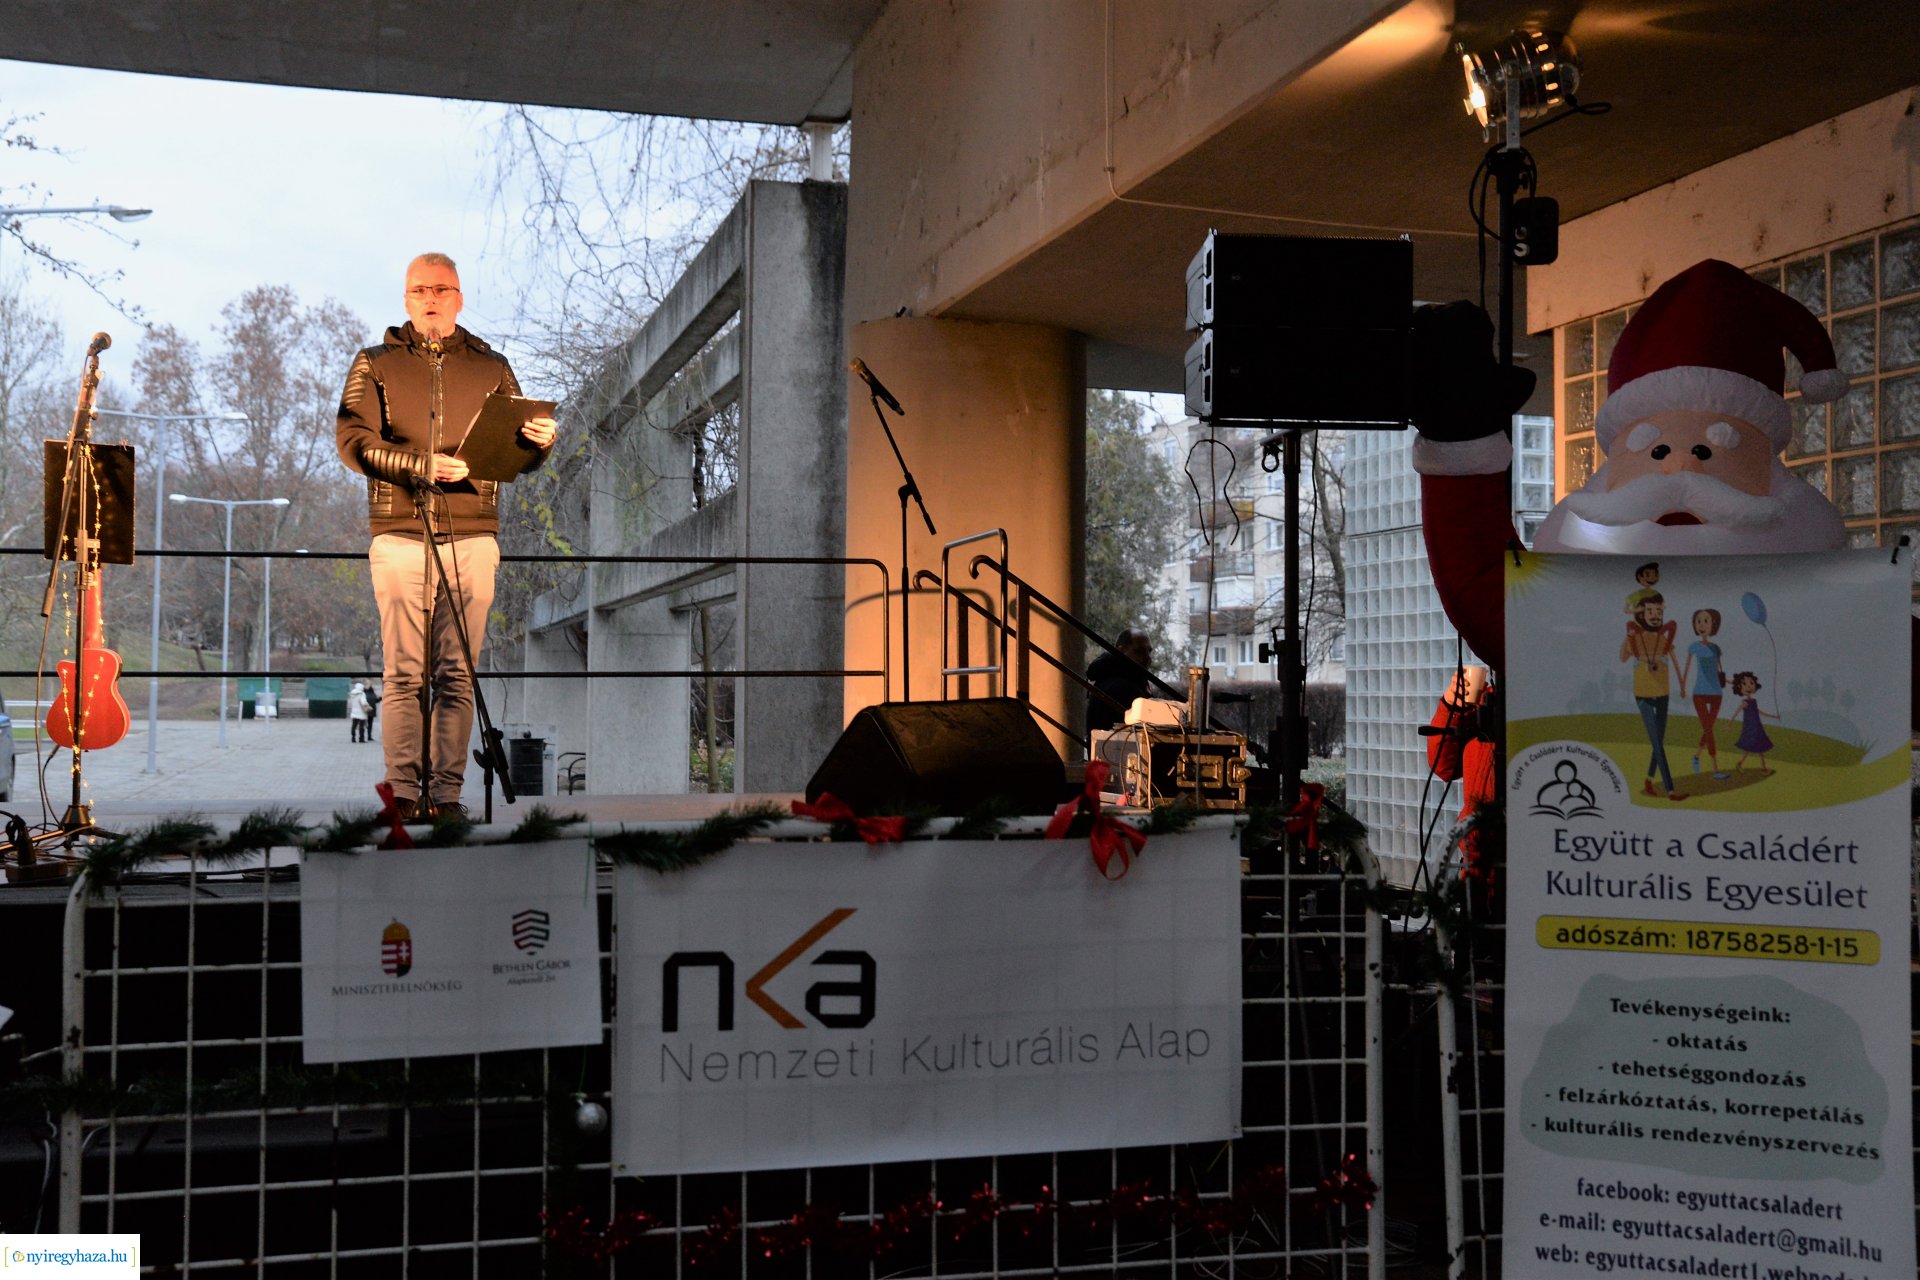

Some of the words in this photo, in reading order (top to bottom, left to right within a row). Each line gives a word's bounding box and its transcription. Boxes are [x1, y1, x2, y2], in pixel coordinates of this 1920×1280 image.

[1555, 828, 1653, 861] Együtt
[1666, 839, 1684, 858] a
[1697, 833, 1859, 864] Családért
[1546, 870, 1692, 901] Kulturális
[1706, 876, 1868, 911] Egyesület
[1556, 924, 1677, 948] adószám:
[1686, 929, 1859, 957] 18758258-1-15
[1610, 998, 1791, 1025] Tevékenységeink:
[660, 1039, 875, 1083] Nemzeti
[902, 1025, 1100, 1074] Kulturális
[1116, 1022, 1211, 1064] Alap
[1667, 1033, 1748, 1052] oktatás
[1611, 1060, 1807, 1088] tehetséggondozás
[1558, 1086, 1718, 1115] felzárkóztatás,
[1725, 1098, 1865, 1125] korrepetálás
[1544, 1117, 1644, 1139] kulturális
[1651, 1127, 1880, 1161] rendezvényszervezés
[1577, 1177, 1670, 1204] facebook:
[1676, 1187, 1844, 1221] egyuttacsaladert
[1536, 1244, 1579, 1264] web:
[1539, 1210, 1606, 1232] e-mail:
[1612, 1216, 1883, 1262] egyuttacsaladert@gmail.hu
